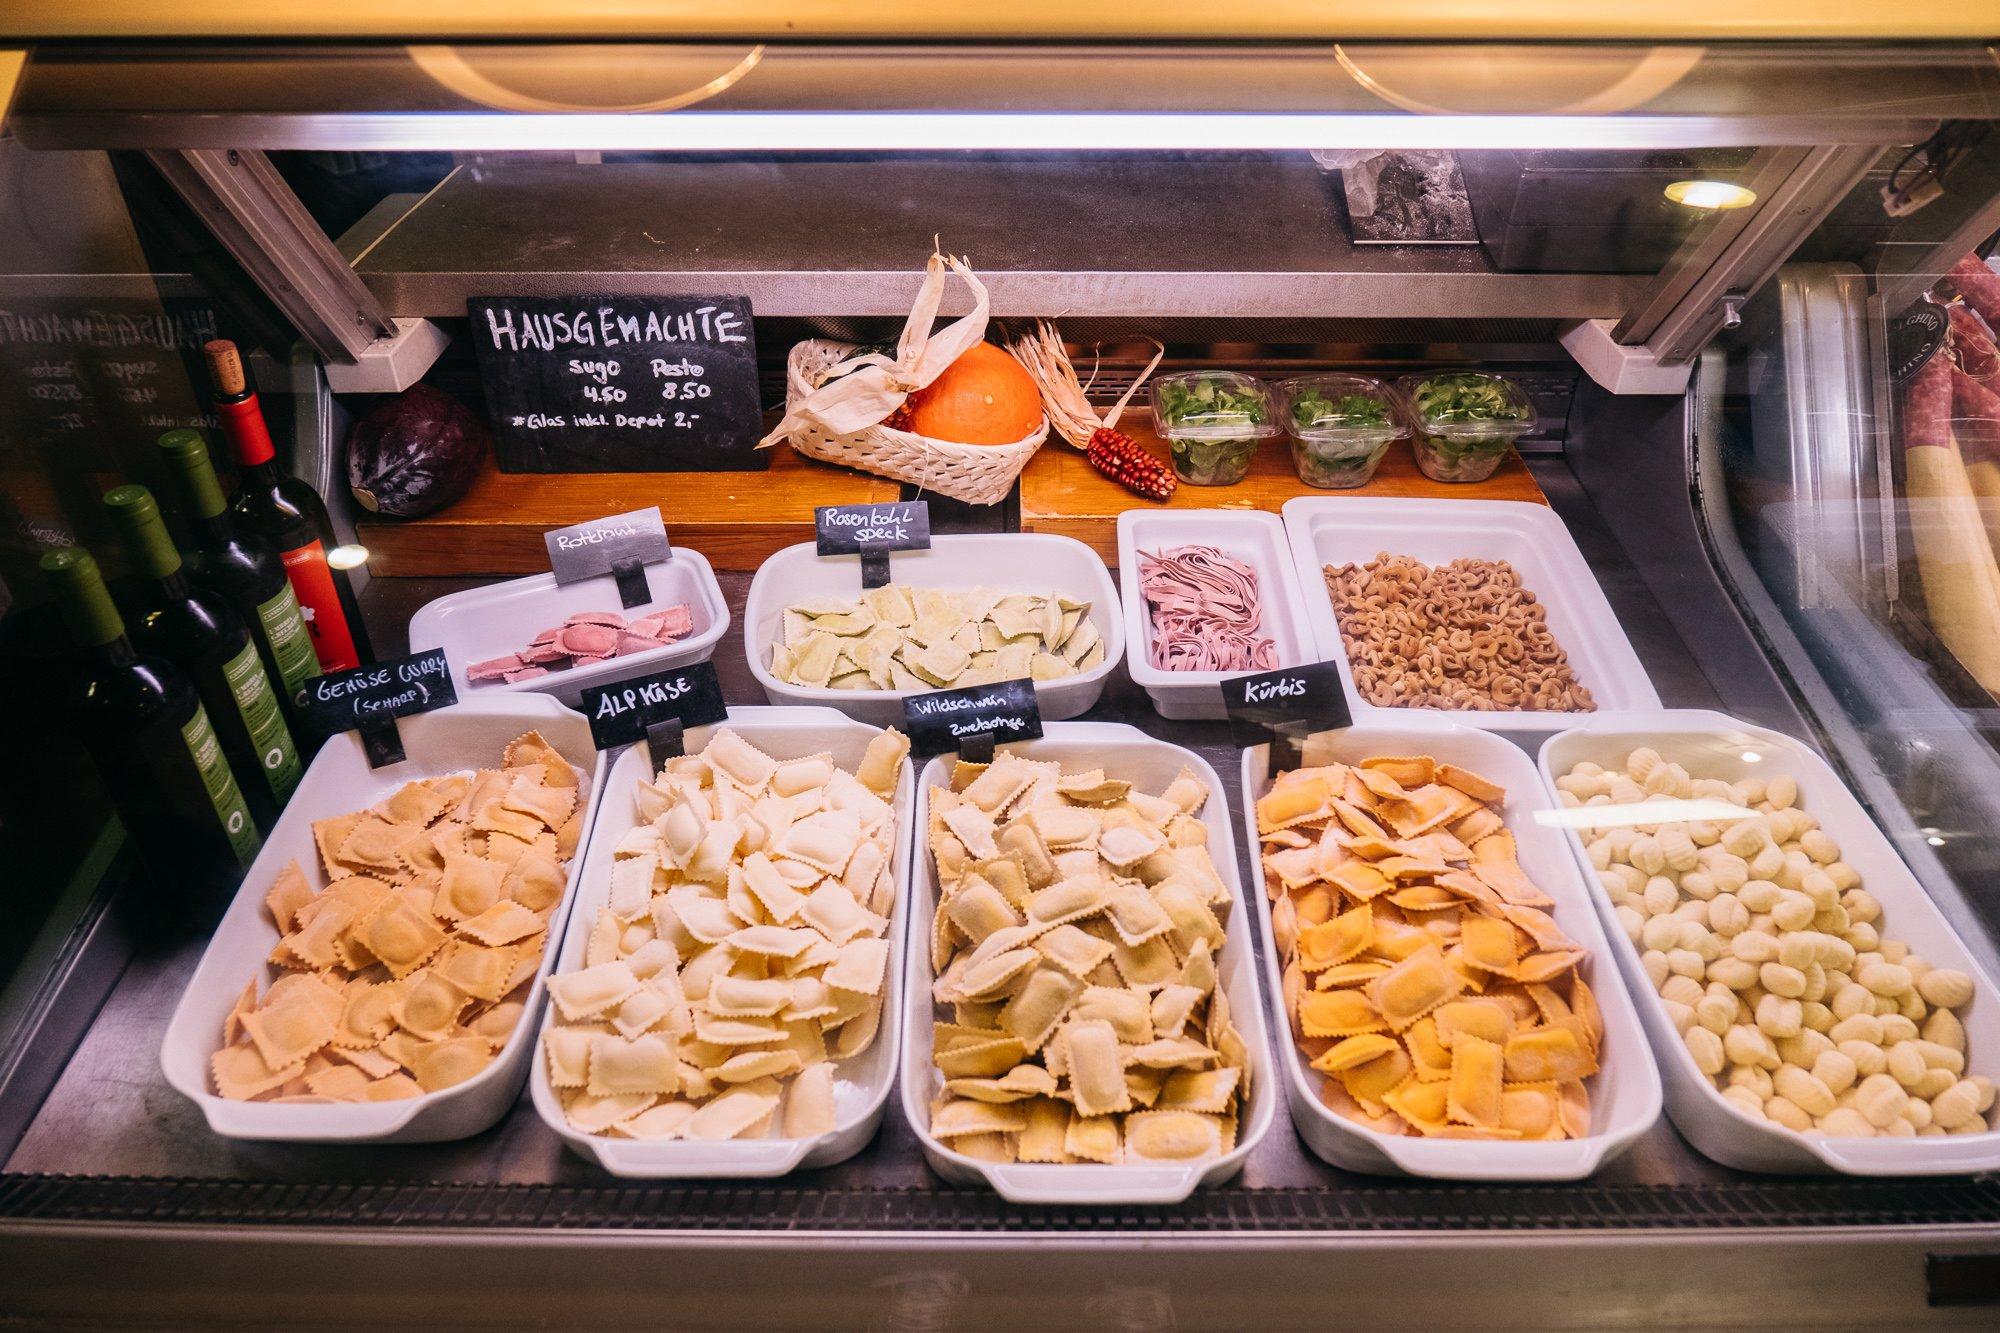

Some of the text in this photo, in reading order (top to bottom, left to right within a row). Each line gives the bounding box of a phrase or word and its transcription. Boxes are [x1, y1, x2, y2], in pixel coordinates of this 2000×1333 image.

[486, 306, 747, 351] HAUSGEMACHTE
[650, 357, 704, 378] Pesto
[584, 382, 711, 403] 4.50 8.50
[615, 414, 666, 430] Depot
[398, 656, 447, 683] CURRY
[1244, 678, 1307, 703] Kürbis
[915, 694, 1007, 715] Wildschwein
